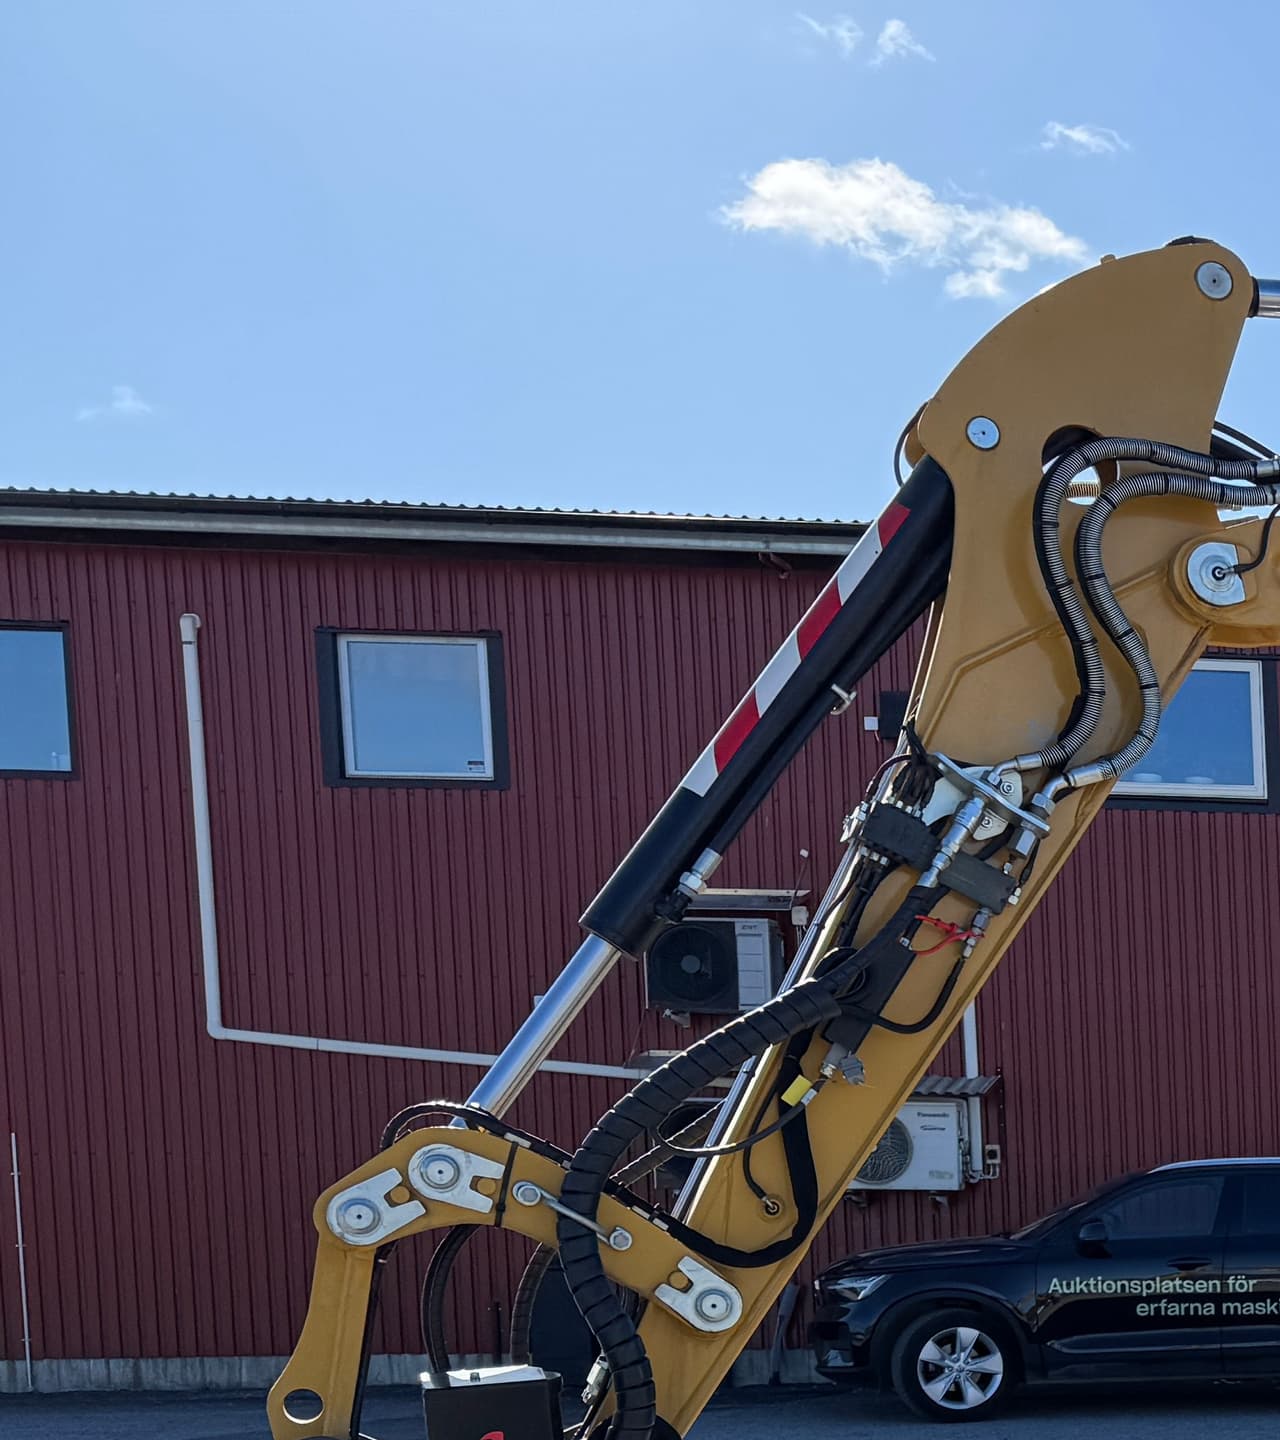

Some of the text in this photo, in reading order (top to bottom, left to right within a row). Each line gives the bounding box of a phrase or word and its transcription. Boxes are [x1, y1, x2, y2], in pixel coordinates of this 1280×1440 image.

[1048, 1275, 1257, 1297] Auktionsplatsen för
[1136, 1298, 1216, 1316] erfarna
